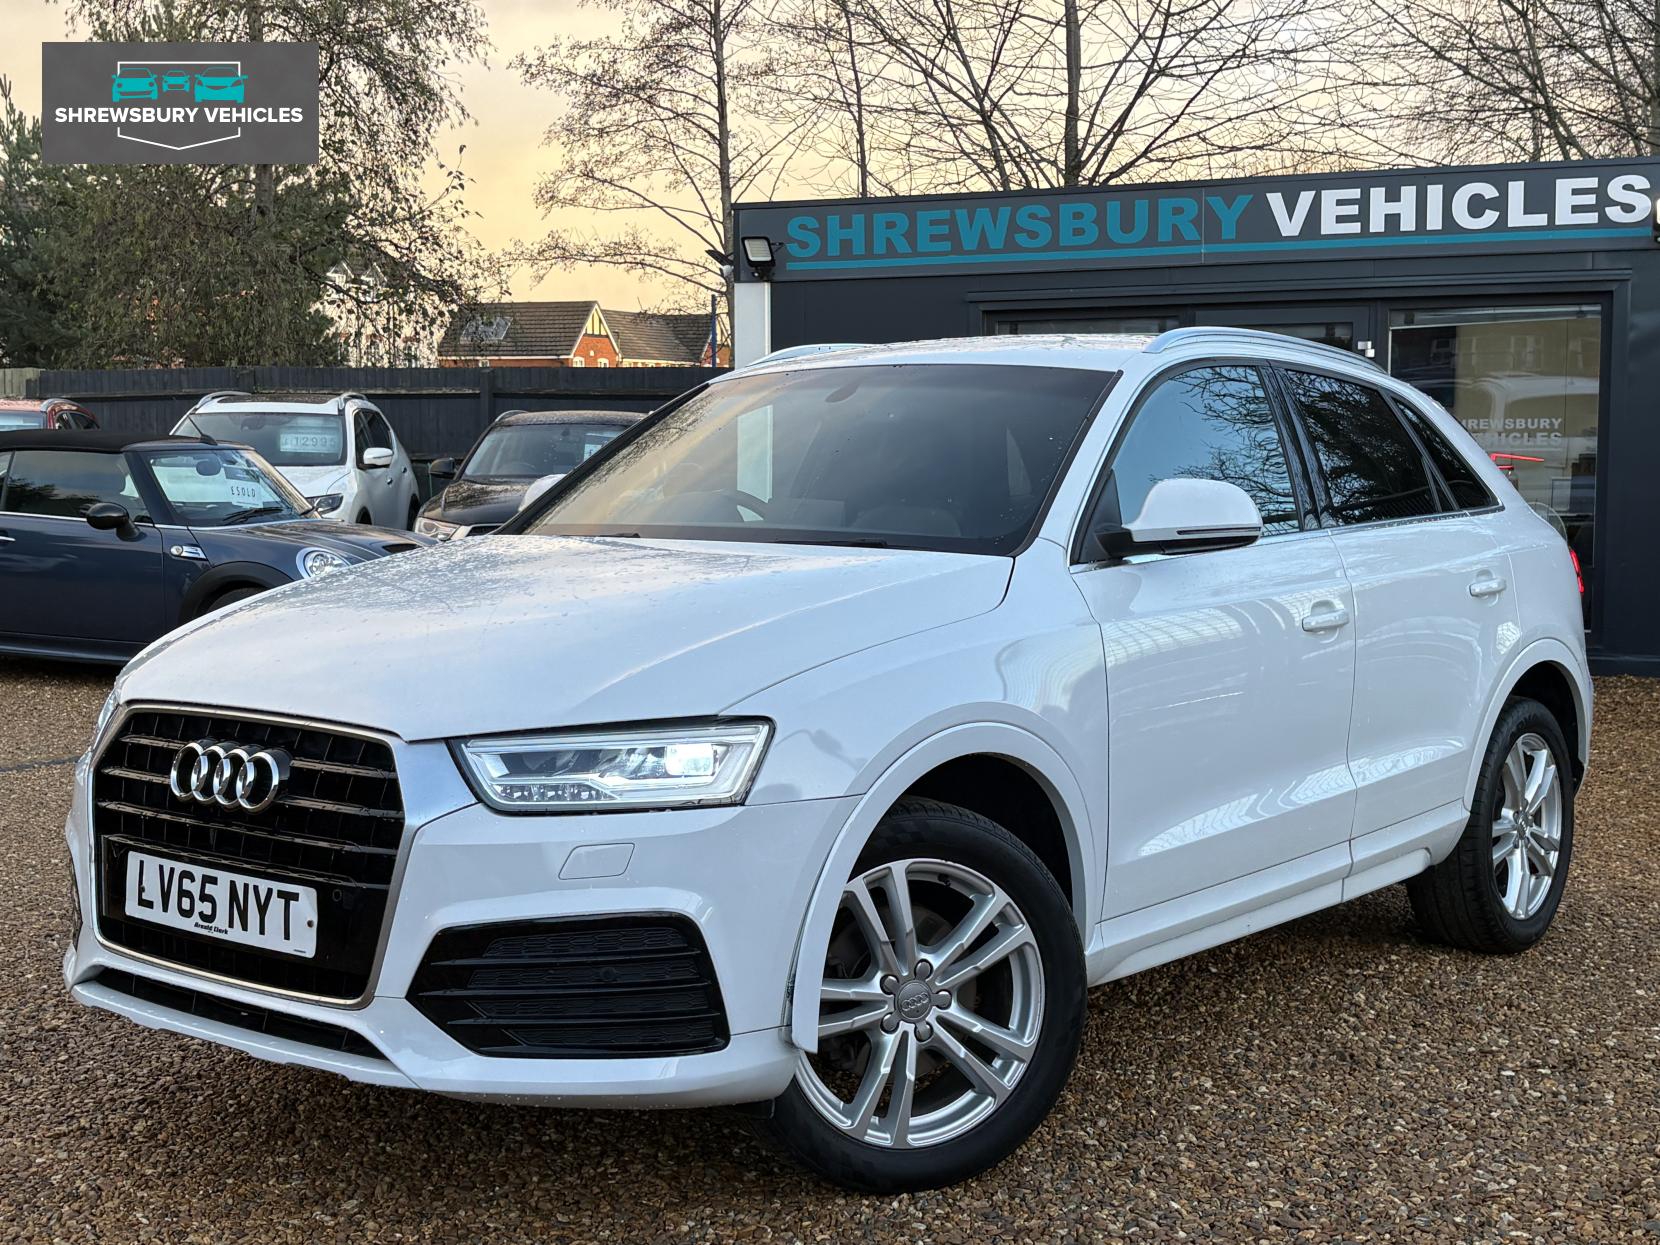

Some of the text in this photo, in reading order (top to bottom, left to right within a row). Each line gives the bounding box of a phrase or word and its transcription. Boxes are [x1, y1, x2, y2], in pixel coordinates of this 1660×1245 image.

[786, 174, 1652, 258] SHREWSBURY VEHICLES
[138, 859, 300, 941] LV65 NYT
